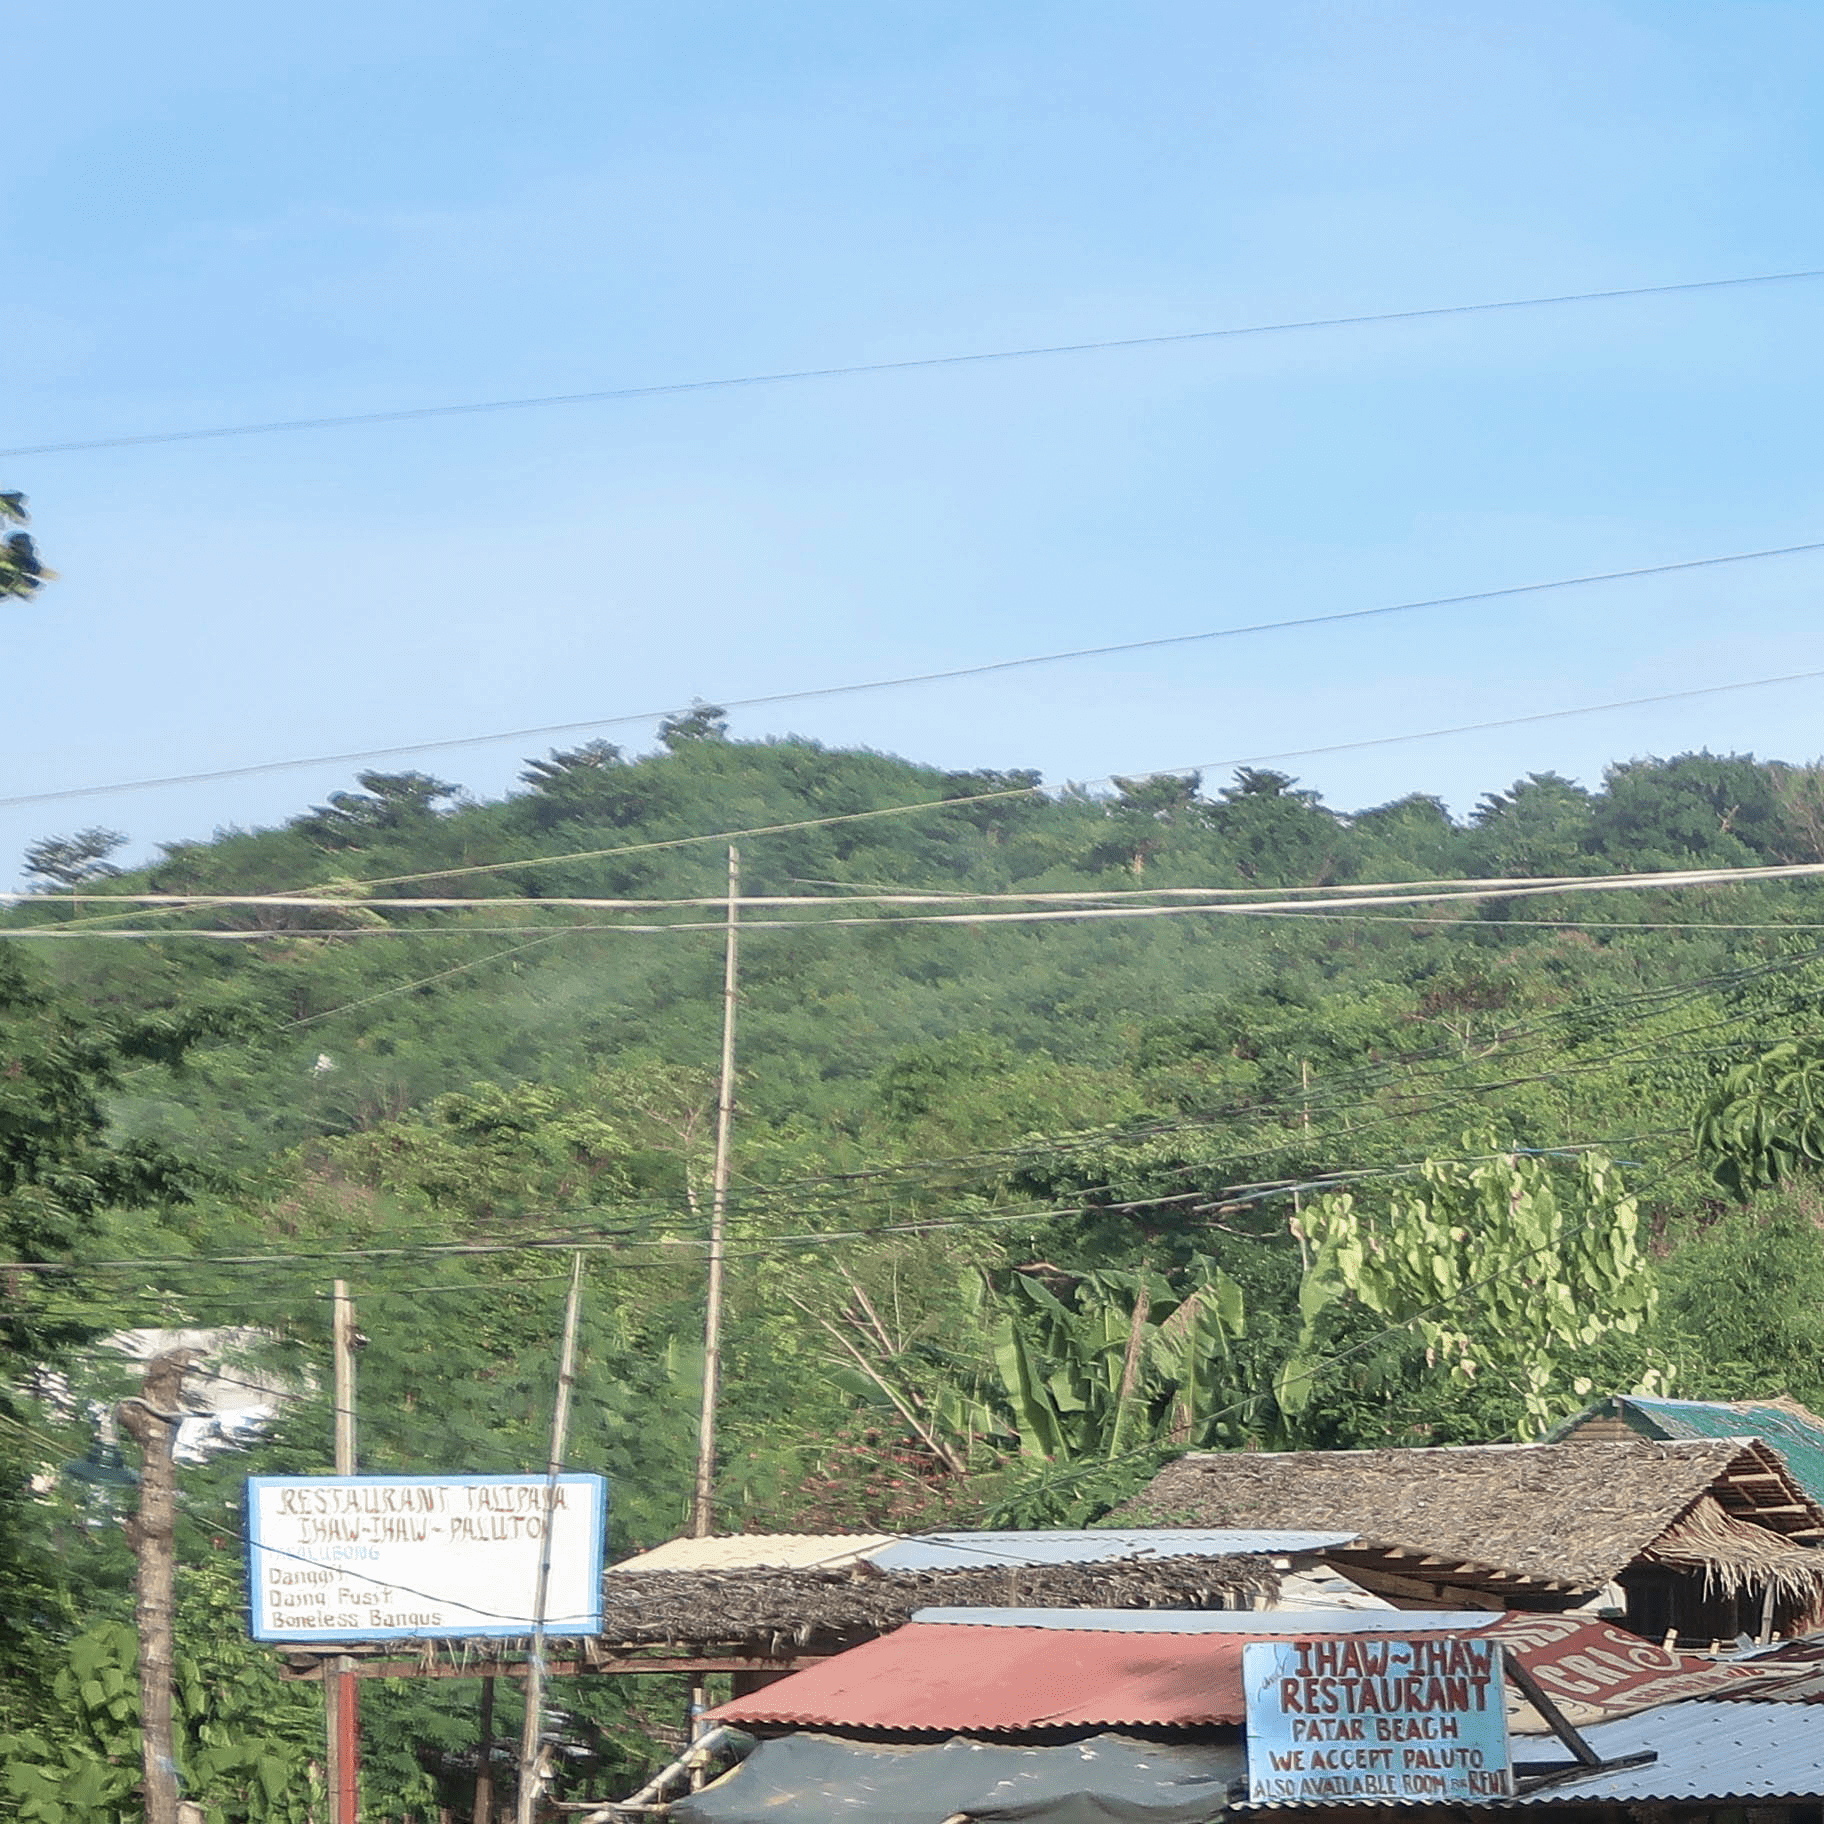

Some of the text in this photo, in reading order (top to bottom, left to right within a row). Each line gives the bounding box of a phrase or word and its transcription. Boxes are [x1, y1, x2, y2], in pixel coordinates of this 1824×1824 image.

[276, 1486, 448, 1515] RESTAURANT
[271, 1608, 442, 1632] Boneless Bangus
[1280, 1677, 1490, 1714] RESTAURANT
[1292, 1717, 1459, 1741] PATAR BEACH
[1269, 1749, 1483, 1771] WE ACCEPT PALUTO
[1254, 1778, 1295, 1798] ALSO
[1403, 1775, 1447, 1796] ROOM
[1468, 1769, 1507, 1796] RENT
